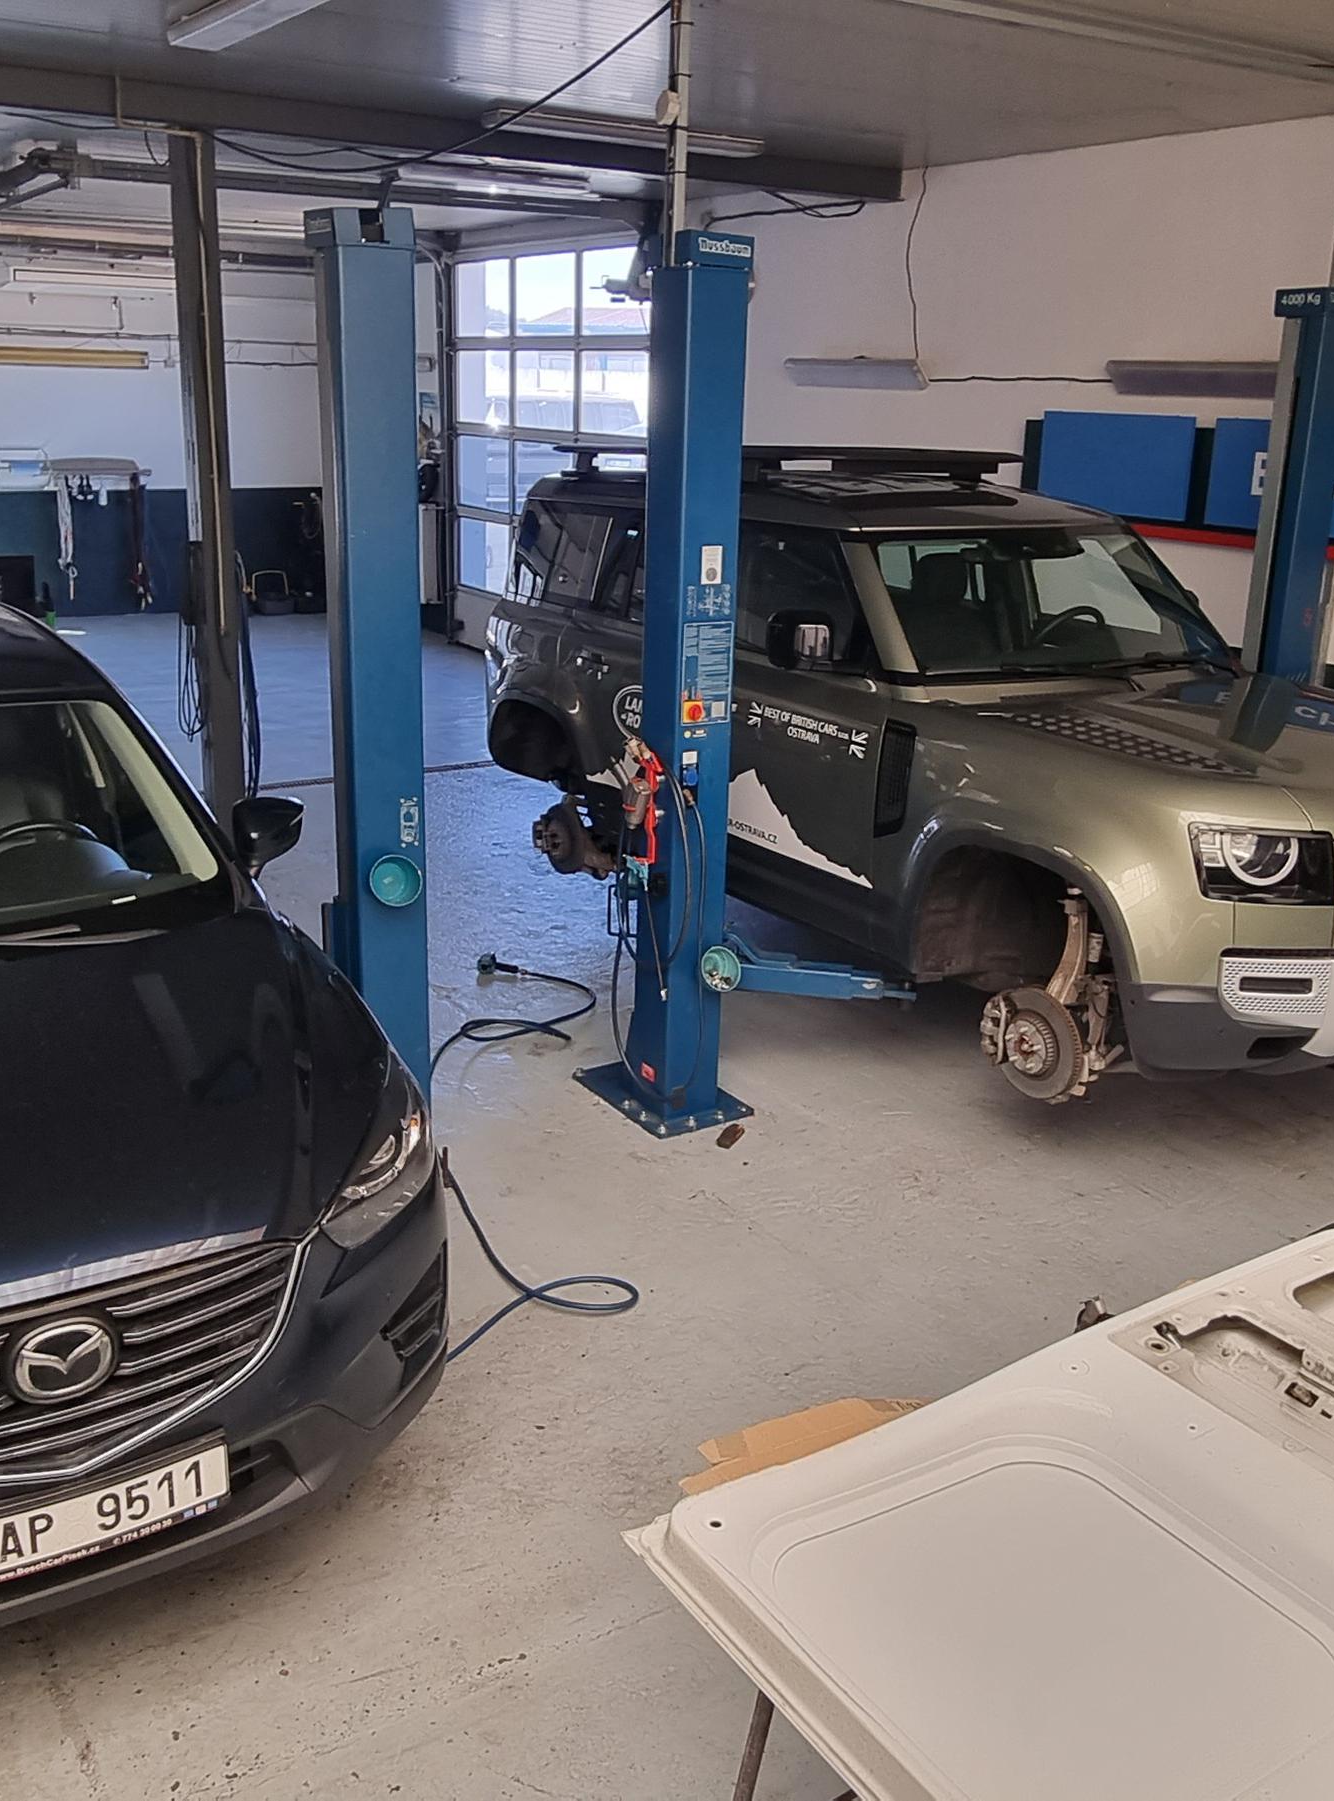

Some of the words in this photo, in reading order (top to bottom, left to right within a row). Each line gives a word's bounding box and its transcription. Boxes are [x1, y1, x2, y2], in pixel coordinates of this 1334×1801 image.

[764, 706, 781, 720] BEST
[780, 711, 792, 722] OF
[791, 714, 818, 732] BRITISH
[818, 721, 839, 737] CARS
[787, 726, 820, 744] OSTRAVA
[96, 1459, 204, 1531] 9511
